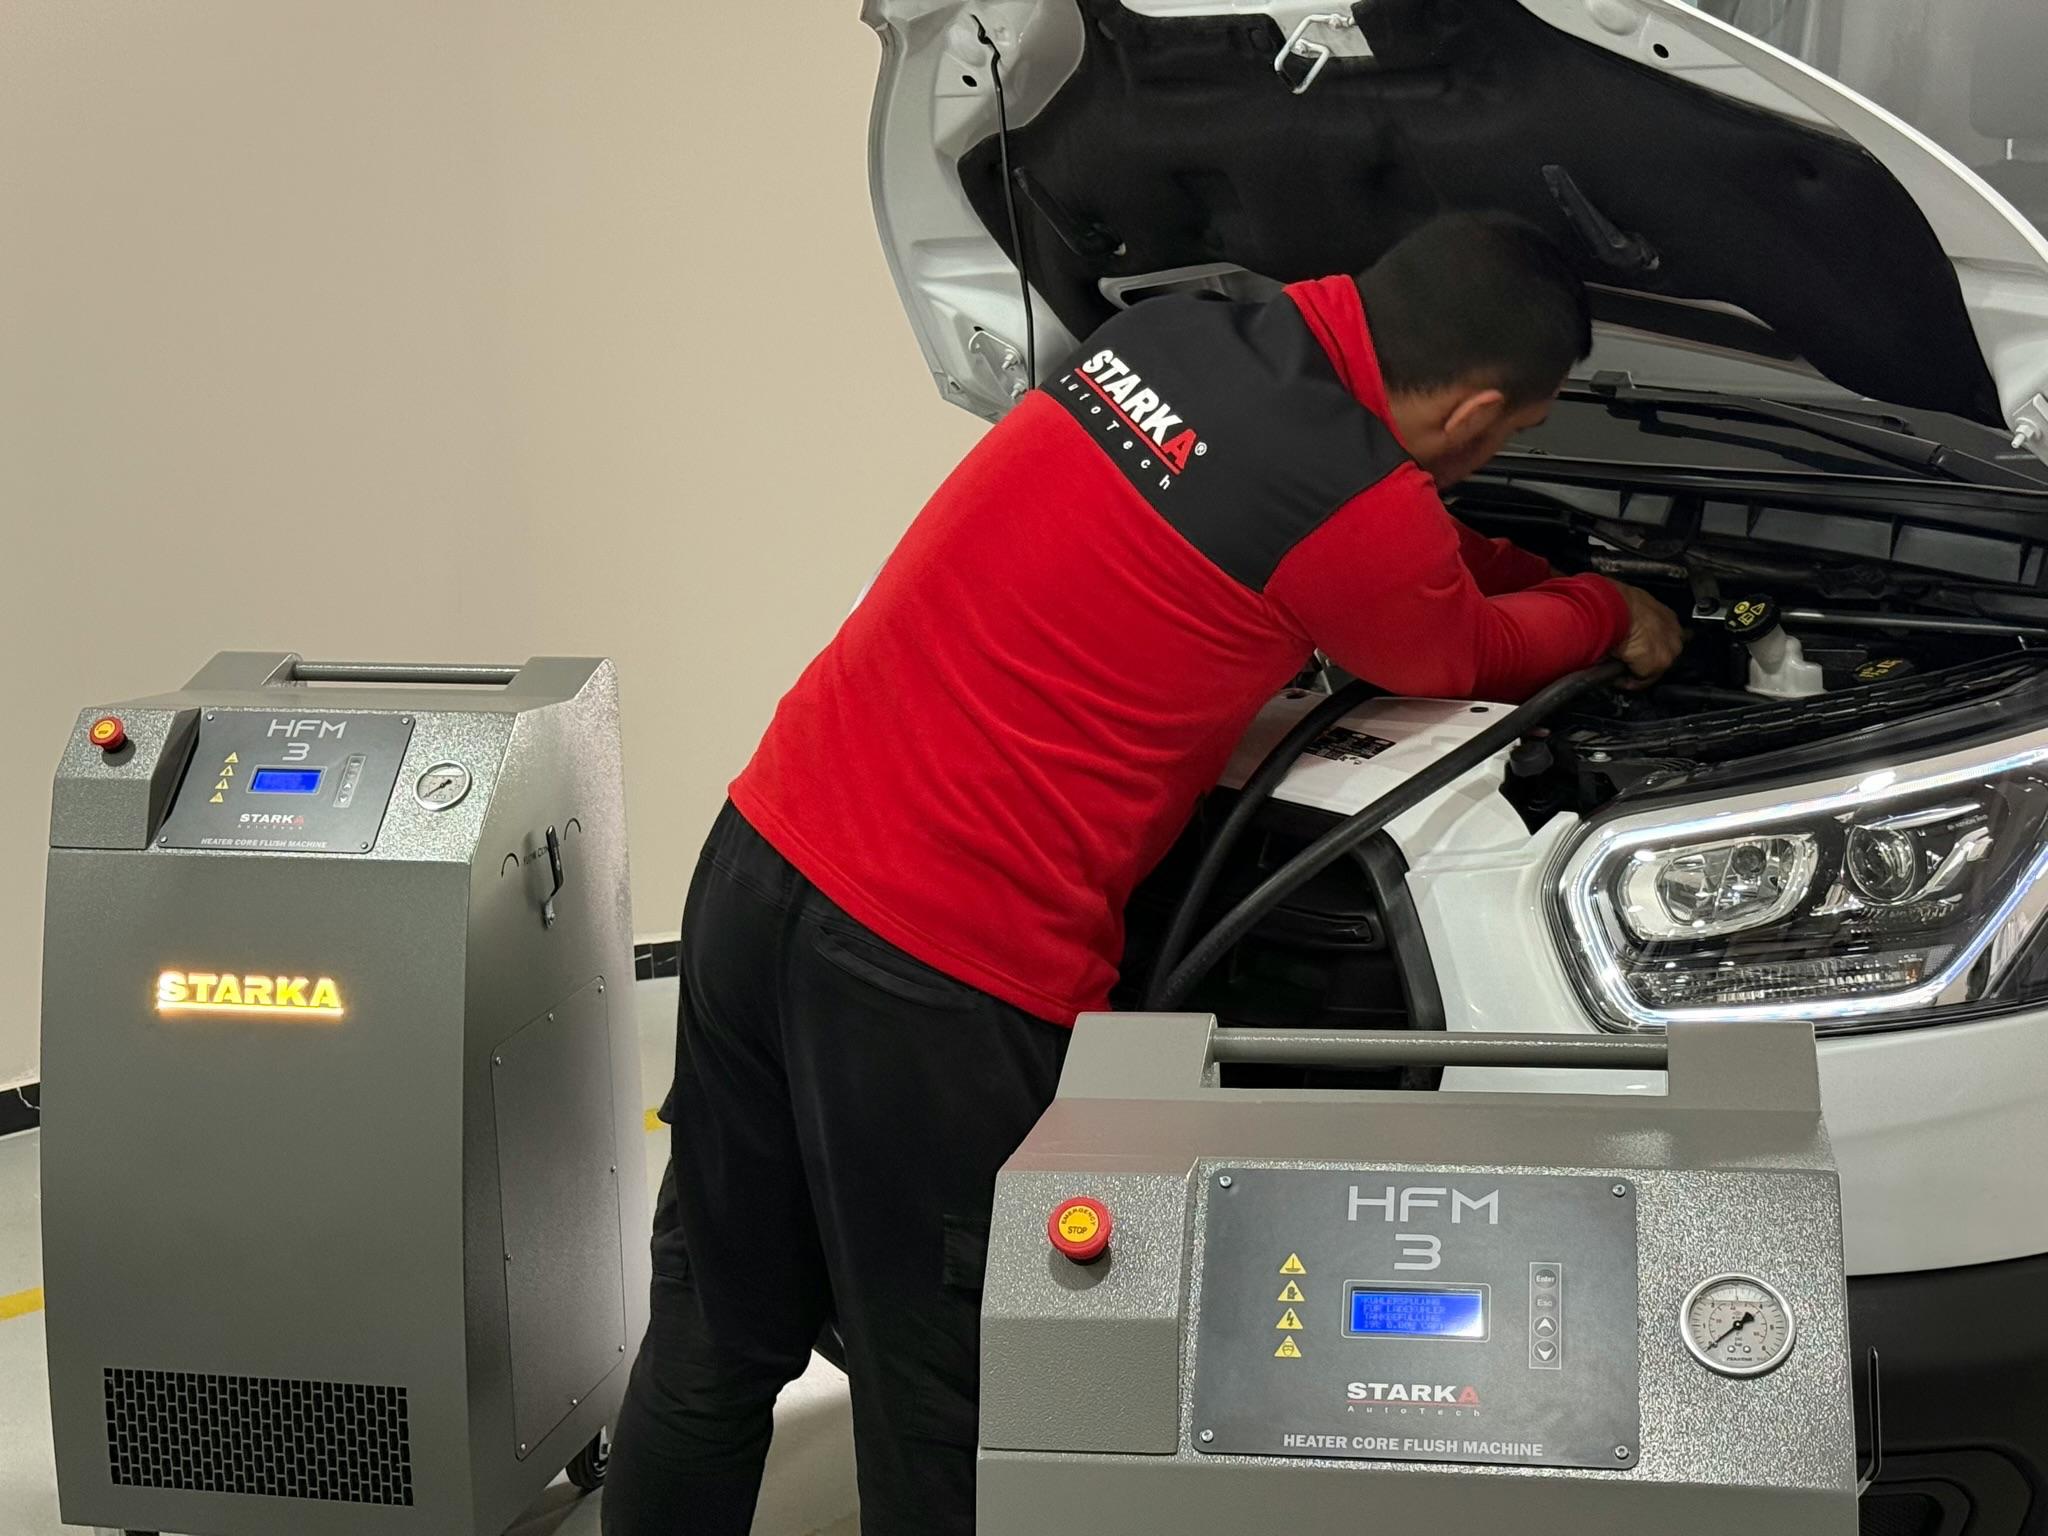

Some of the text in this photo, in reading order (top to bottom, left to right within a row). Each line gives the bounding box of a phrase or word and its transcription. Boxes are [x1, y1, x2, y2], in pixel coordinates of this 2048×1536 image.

[267, 719, 347, 739] HFM
[282, 742, 311, 761] 3
[240, 813, 304, 824] STARKA
[200, 838, 328, 849] HEATER CORE FLUSH MACHINE
[158, 971, 343, 1009] STARKA
[1347, 1185, 1499, 1225] HFM
[1061, 1207, 1096, 1226] EMERGENCY
[1067, 1226, 1088, 1234] STOP
[1394, 1233, 1442, 1271] 3
[1347, 1382, 1479, 1404] STARKA
[1347, 1405, 1480, 1417] AutoTech
[1283, 1434, 1543, 1456] HEATER CORE FLUSH MACHINE
